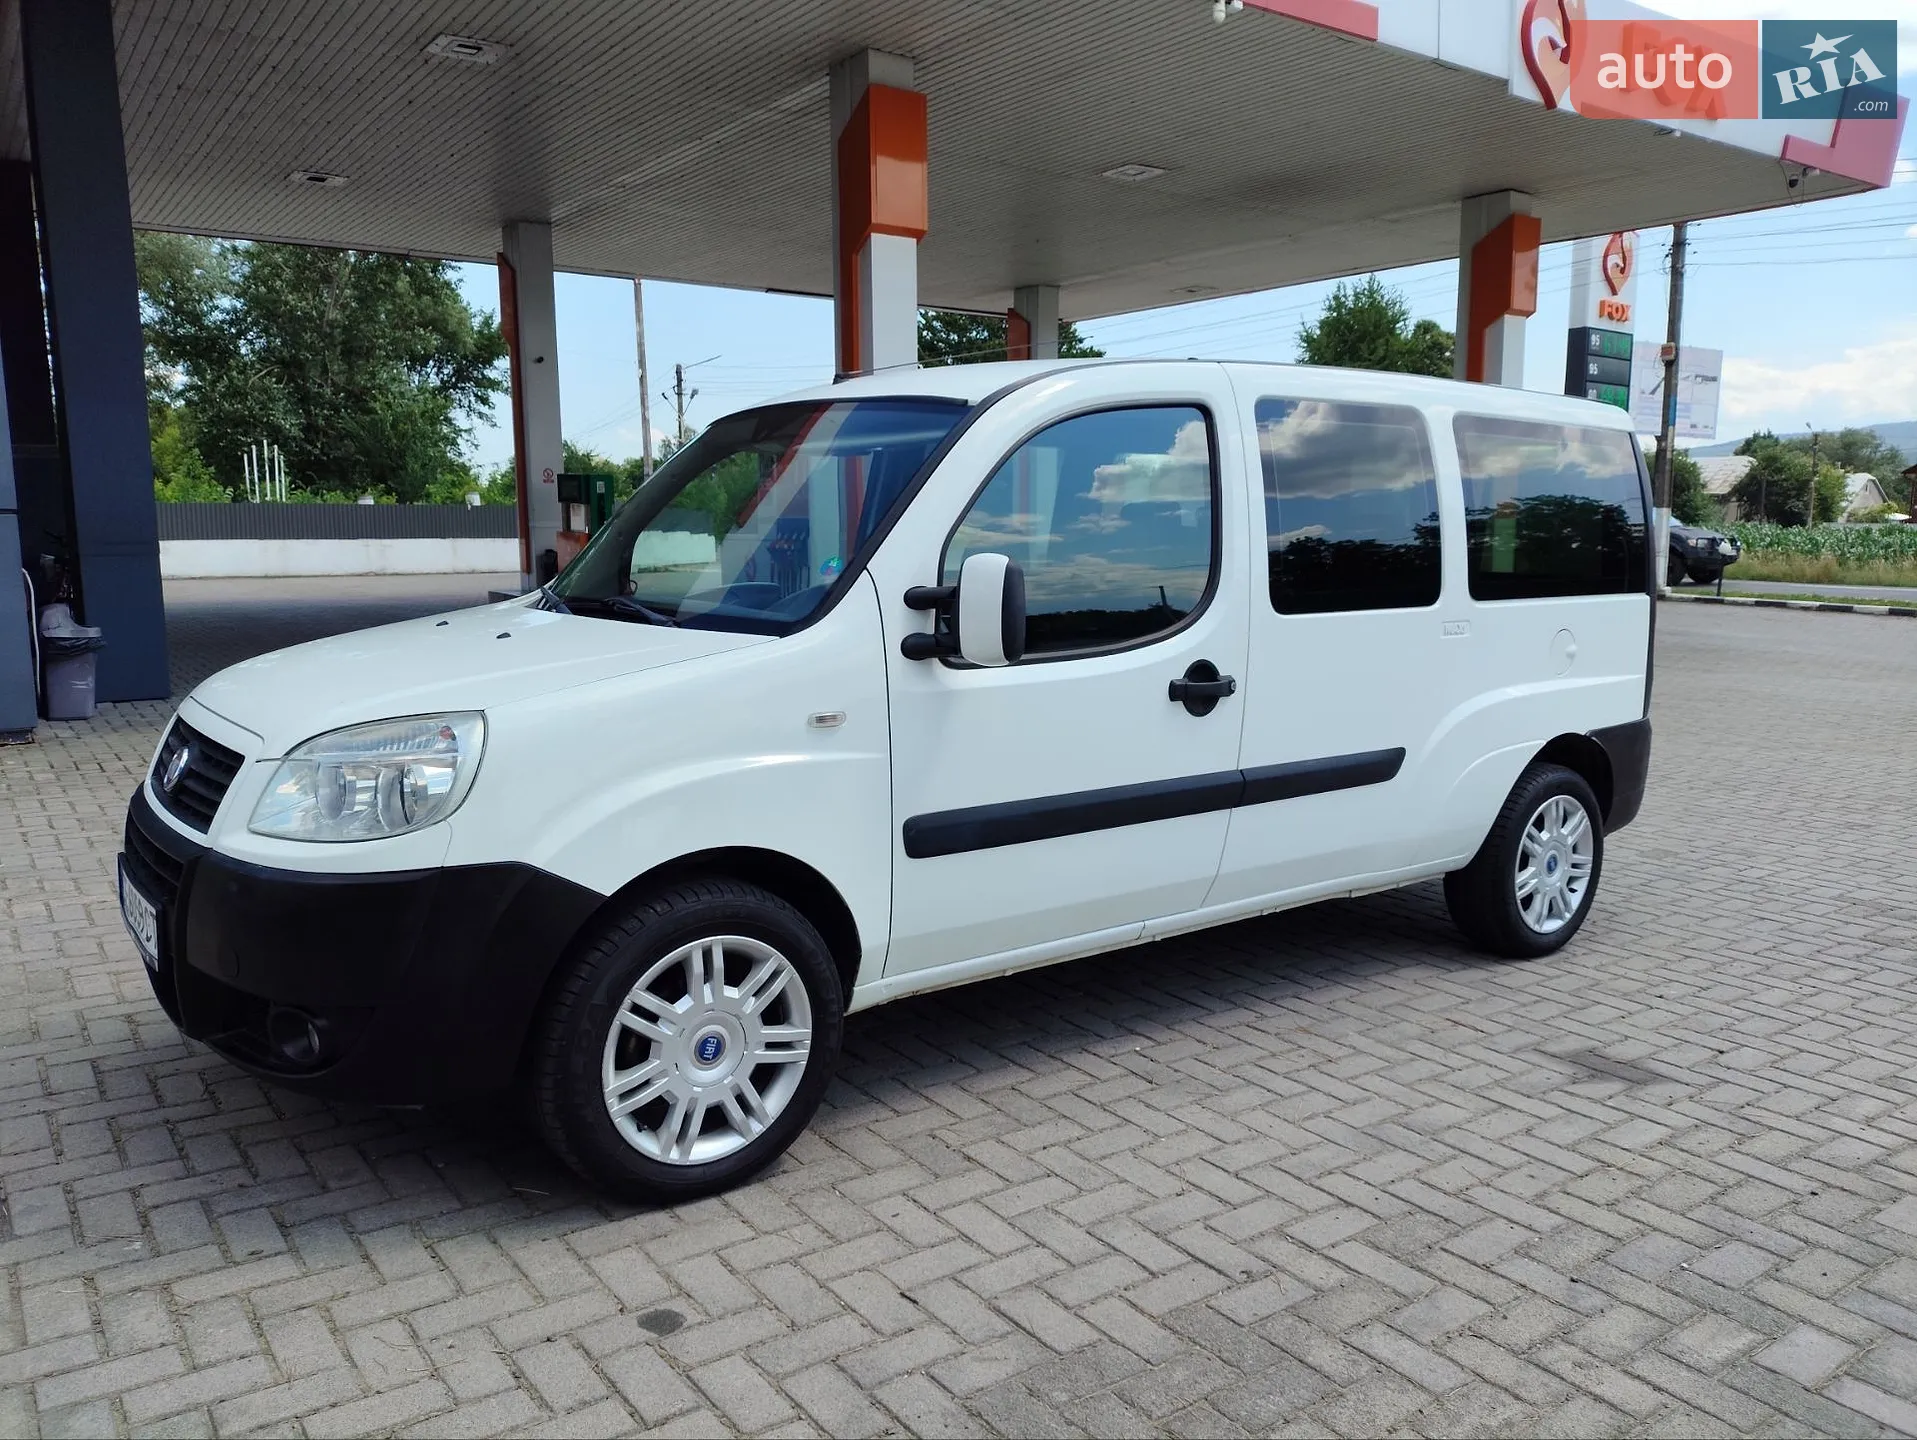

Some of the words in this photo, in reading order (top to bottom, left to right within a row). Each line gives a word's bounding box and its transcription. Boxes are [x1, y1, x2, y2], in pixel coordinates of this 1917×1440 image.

[1599, 300, 1631, 323] FOX
[1591, 333, 1600, 346] 95
[1589, 362, 1598, 375] 95
[703, 1038, 717, 1060] FIAT
